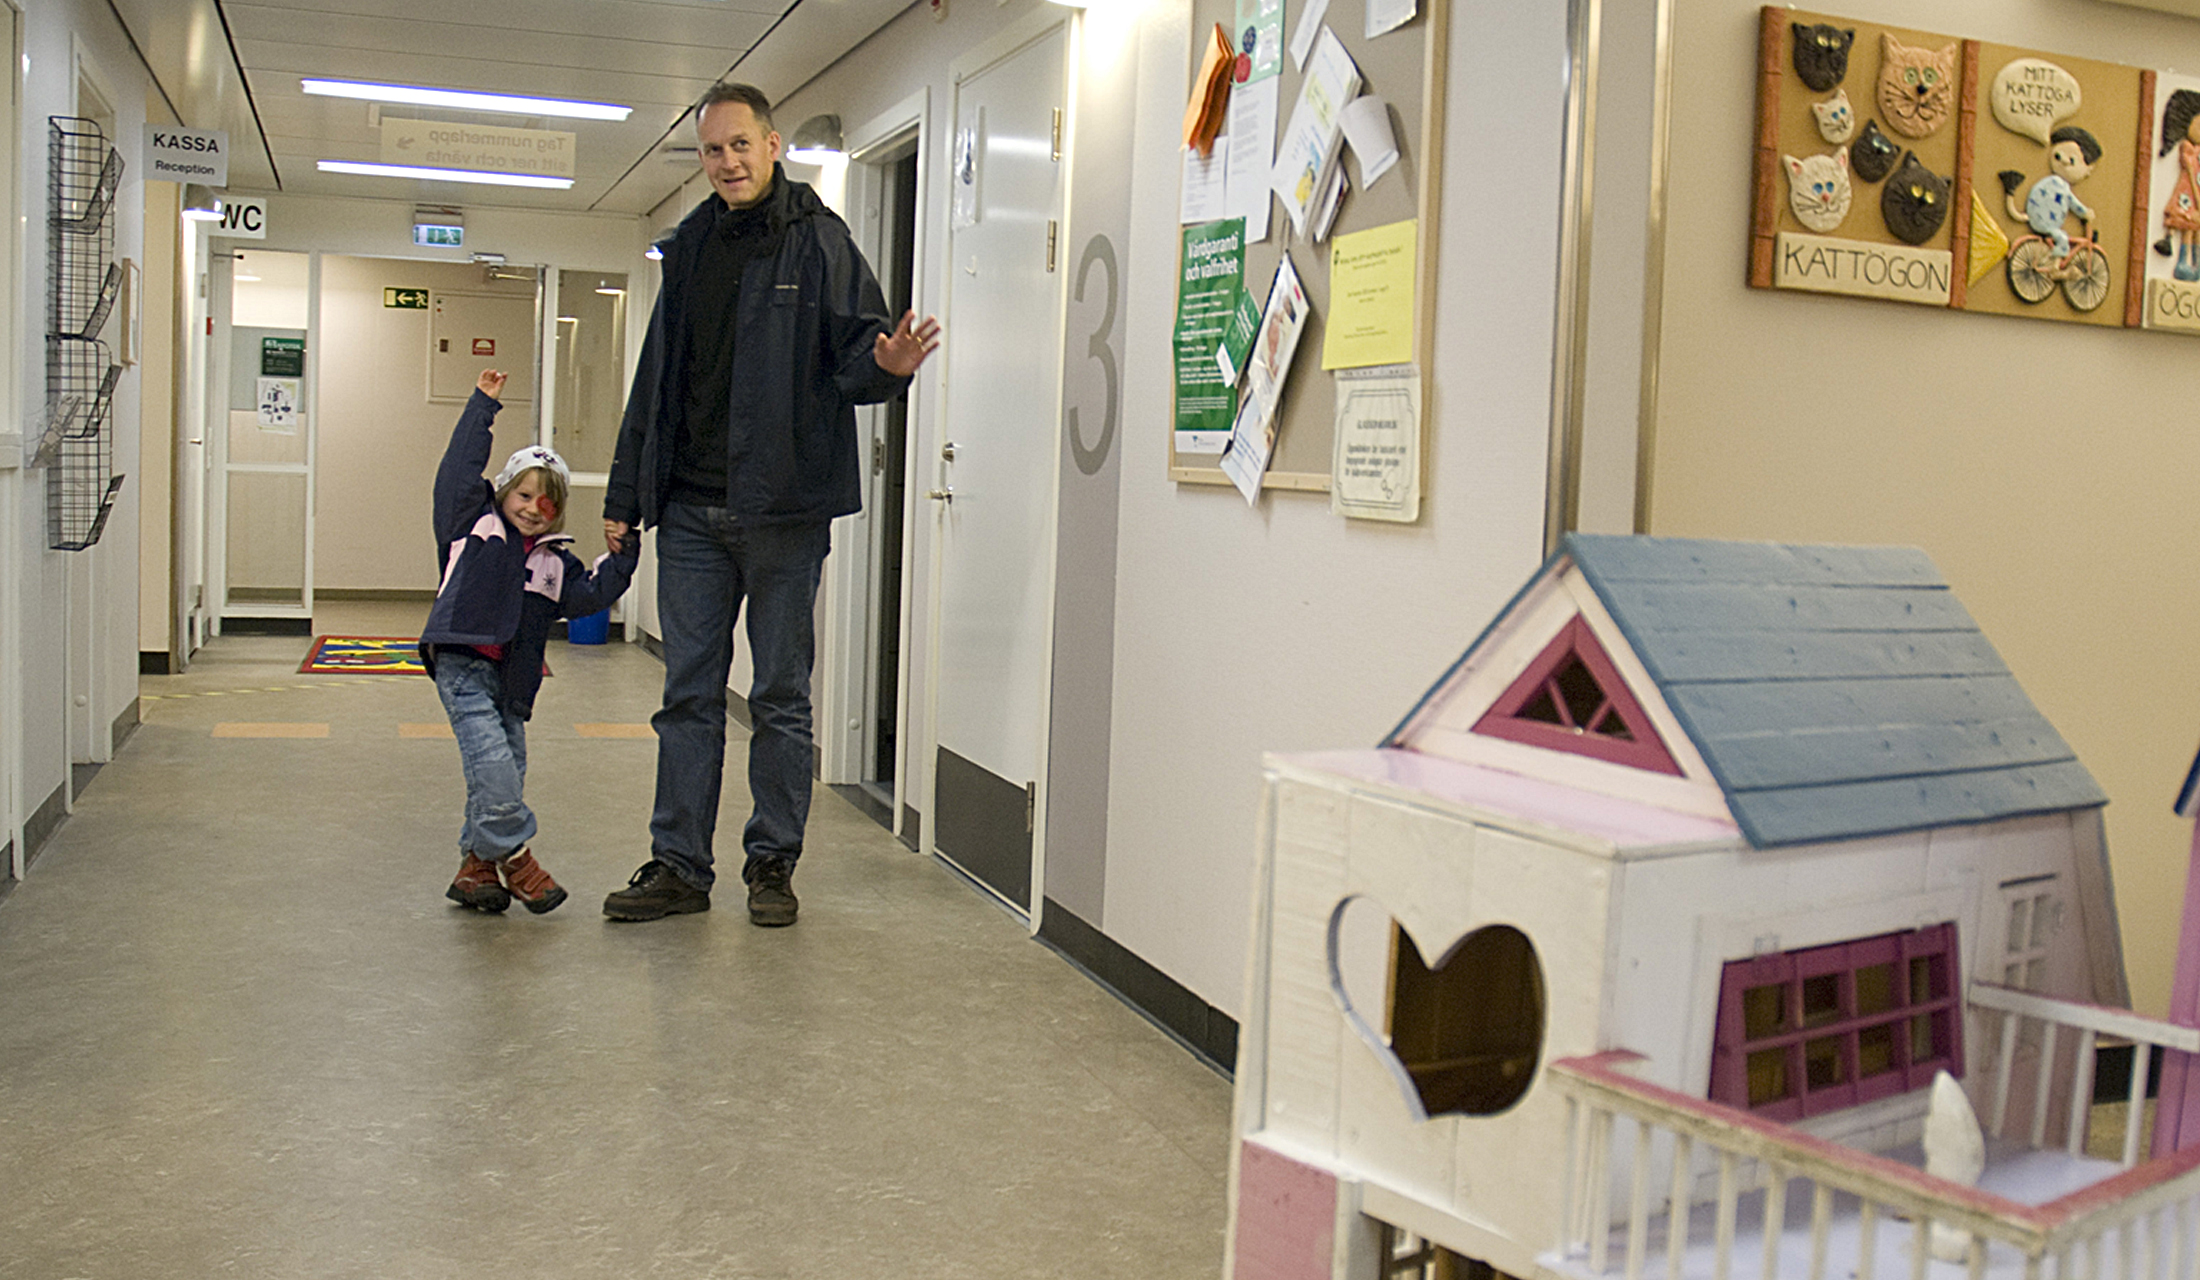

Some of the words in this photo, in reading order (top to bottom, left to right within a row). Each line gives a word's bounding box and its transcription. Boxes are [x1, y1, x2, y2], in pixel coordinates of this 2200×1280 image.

[2024, 66, 2055, 82] MITT
[2010, 100, 2054, 118] LYSER
[153, 133, 219, 153] KASSA
[155, 160, 215, 175] Reception
[219, 203, 262, 232] WC
[1187, 231, 1239, 260] Vårdgaranti
[1185, 261, 1200, 281] och
[1201, 256, 1239, 278] valfrihet
[1785, 242, 1948, 293] KATTÖGON
[1069, 233, 1118, 476] 3
